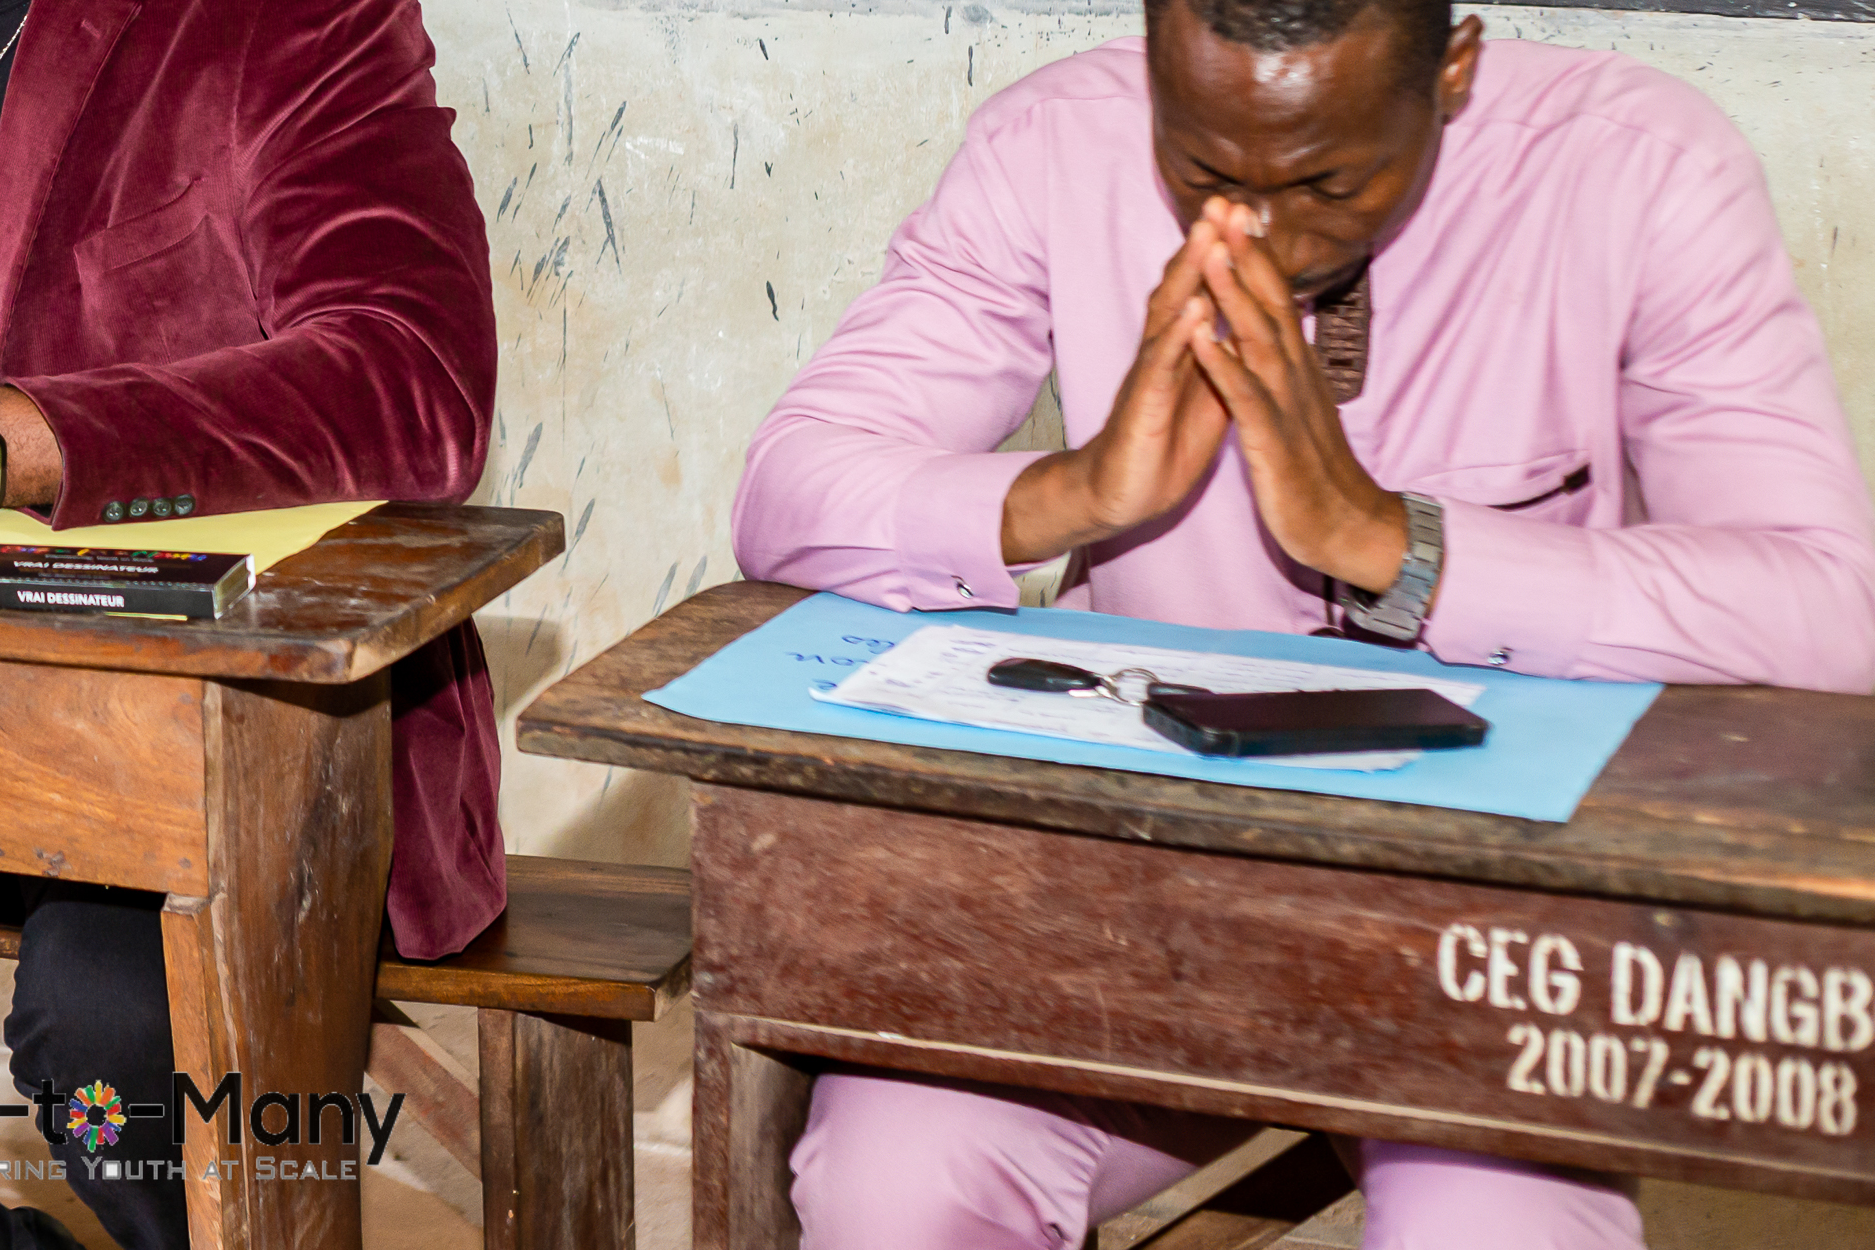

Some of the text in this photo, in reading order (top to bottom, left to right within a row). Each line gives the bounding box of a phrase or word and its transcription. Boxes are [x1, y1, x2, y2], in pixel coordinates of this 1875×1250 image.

[13, 560, 159, 574] VRAI DESSINATEUR
[16, 590, 125, 608] VRAI DESSINATEUR
[1437, 922, 1875, 1052] CEG DANGB
[1505, 1024, 1859, 1136] 2007-2008
